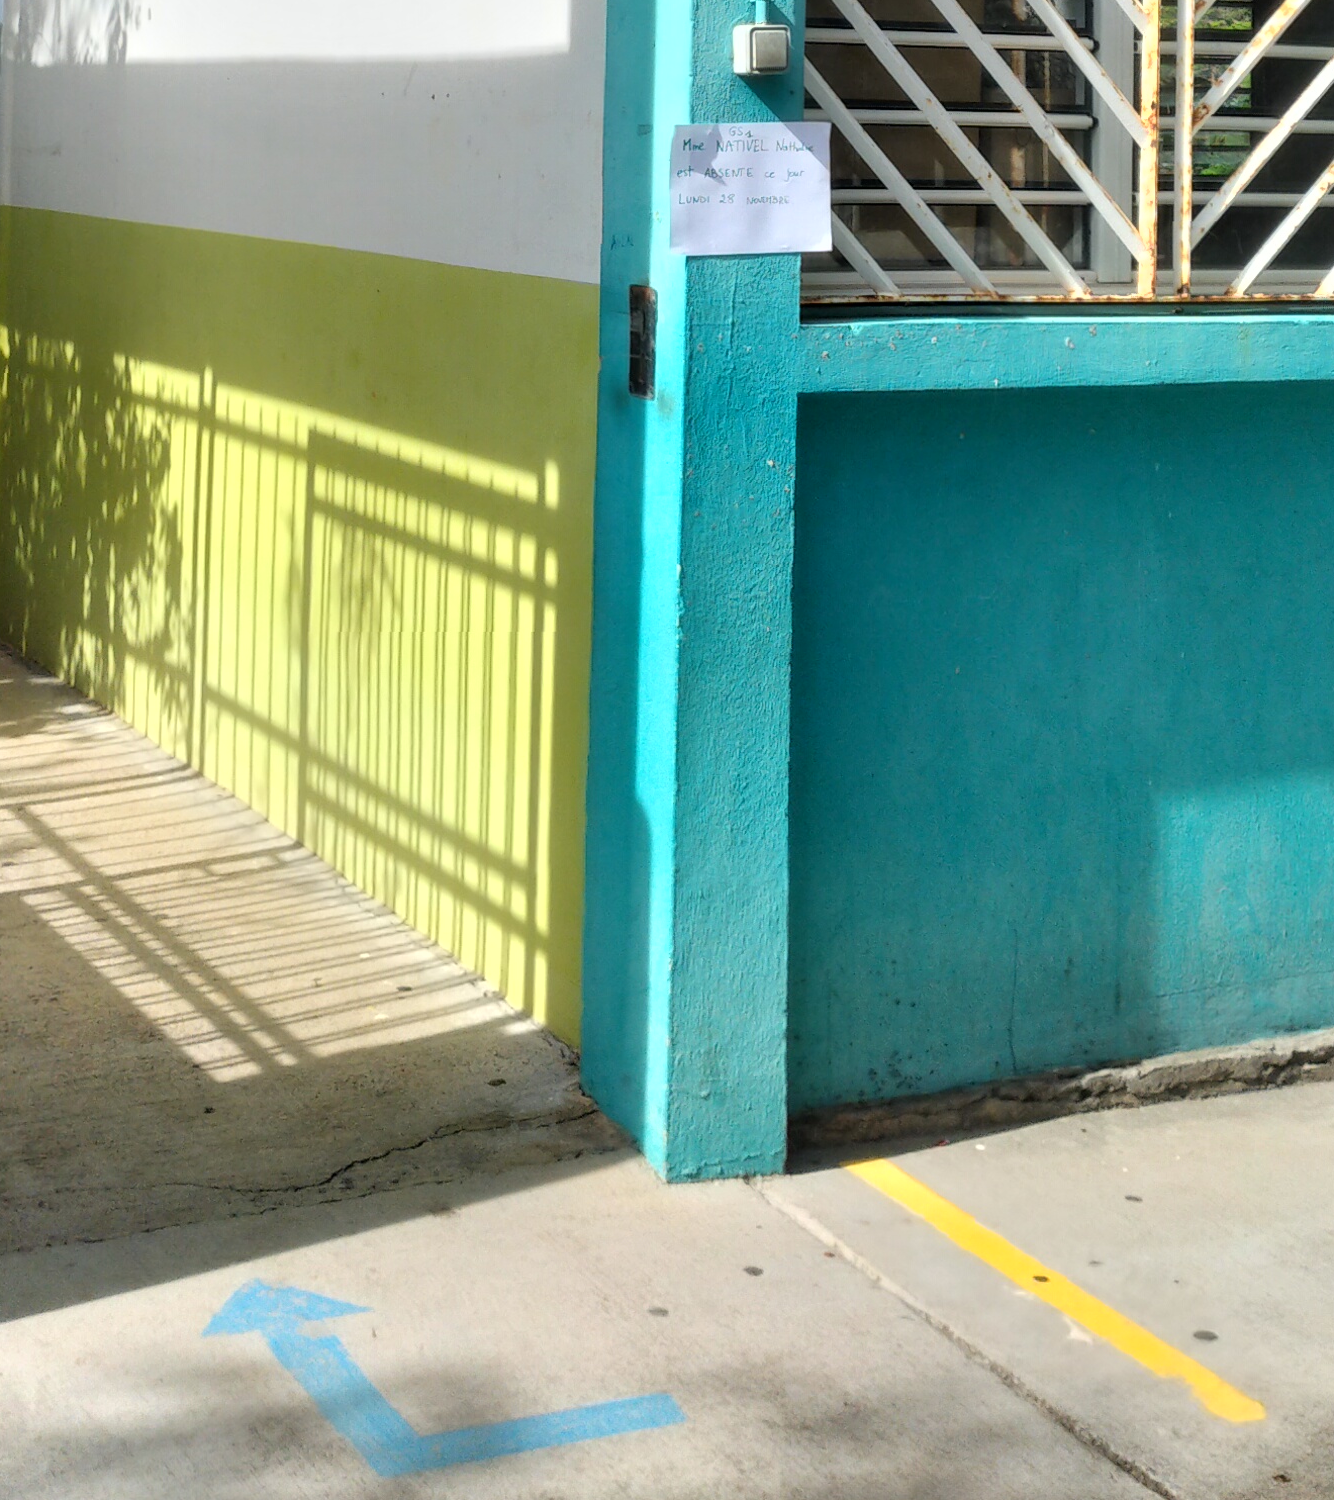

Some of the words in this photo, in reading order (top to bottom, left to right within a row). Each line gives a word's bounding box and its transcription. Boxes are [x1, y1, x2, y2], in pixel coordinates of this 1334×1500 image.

[682, 138, 705, 152] Mme
[717, 138, 769, 153] NATIVEL
[676, 165, 695, 179] est
[704, 166, 755, 179] ABSENTE
[764, 170, 776, 179] ce
[783, 167, 806, 183] jour
[678, 193, 711, 206] LUNDI
[718, 193, 736, 205] 28
